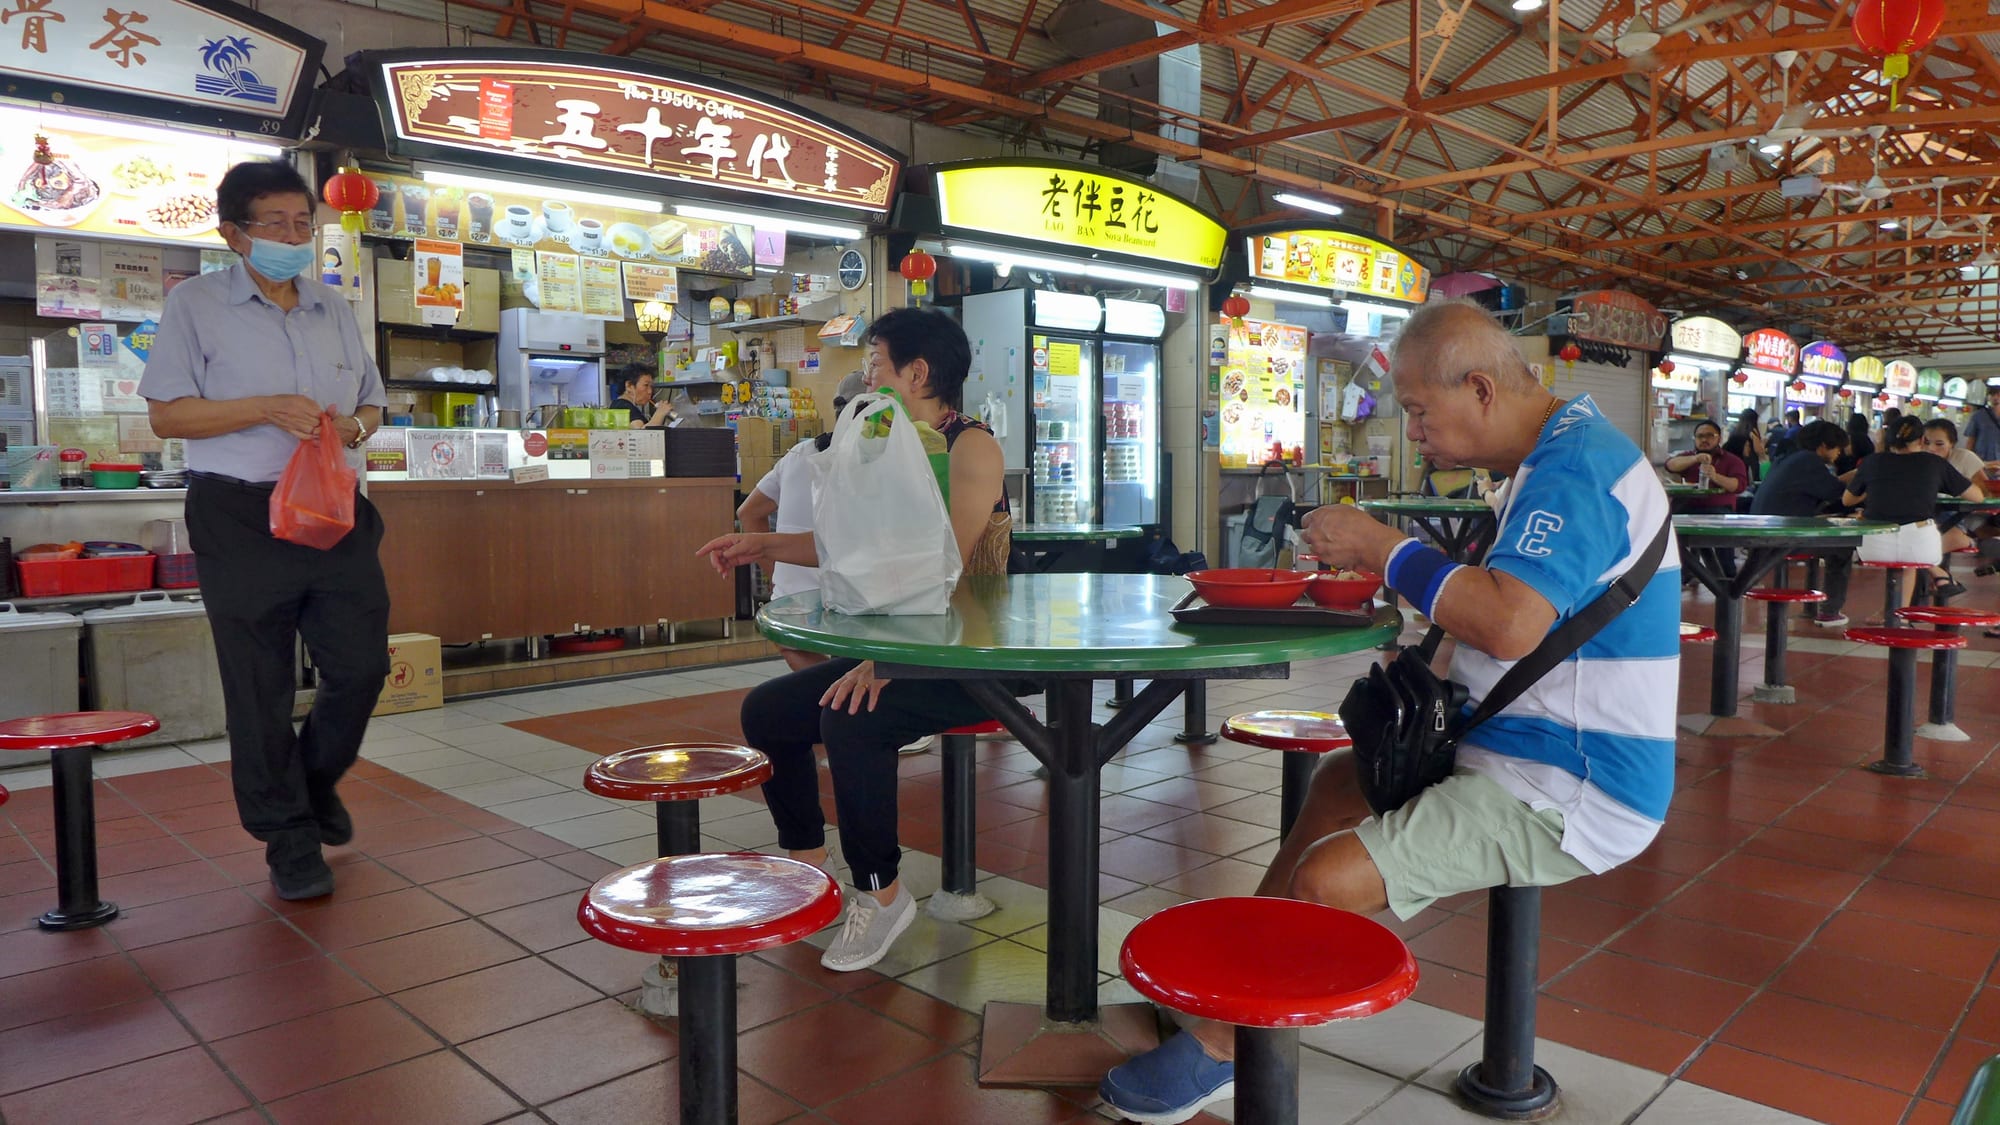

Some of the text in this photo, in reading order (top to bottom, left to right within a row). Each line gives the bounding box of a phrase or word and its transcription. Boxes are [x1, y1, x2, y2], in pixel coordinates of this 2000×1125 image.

[1, 0, 161, 68] 骨茶
[618, 81, 648, 100] The
[705, 100, 745, 119] Coffee
[260, 120, 280, 134] 89
[542, 99, 798, 189] 五十年代
[872, 212, 884, 223] 90
[1042, 173, 1158, 234] 老伴豆花
[1045, 219, 1064, 232] LAO
[1077, 225, 1096, 237] BAN
[1567, 317, 1578, 335] 93
